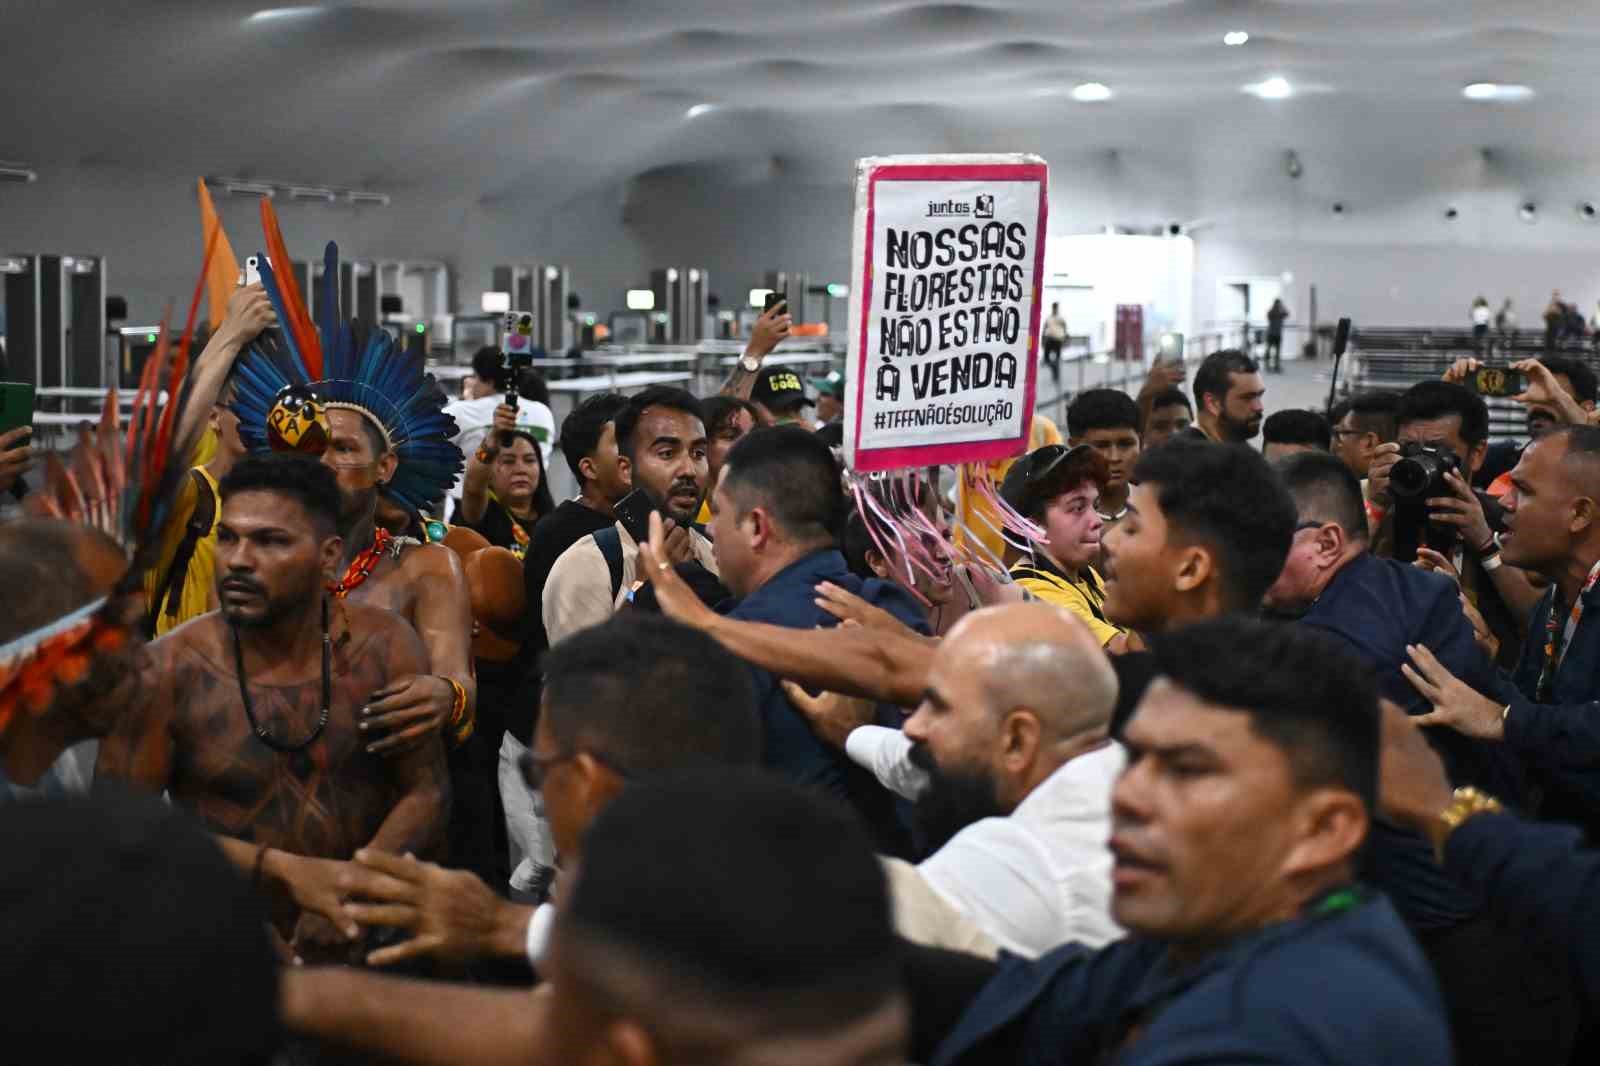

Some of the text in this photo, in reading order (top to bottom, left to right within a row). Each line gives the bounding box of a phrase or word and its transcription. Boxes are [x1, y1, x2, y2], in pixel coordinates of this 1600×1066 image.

[926, 200, 970, 217] juntos
[886, 221, 1027, 269] NOSSAS
[884, 263, 1024, 313] FLORESTAS
[880, 302, 1020, 357] NÃO ESTÃO
[876, 352, 1017, 401] À VENDA
[874, 400, 1013, 429] #TFFFNÃOÉSOLUÇÃO
